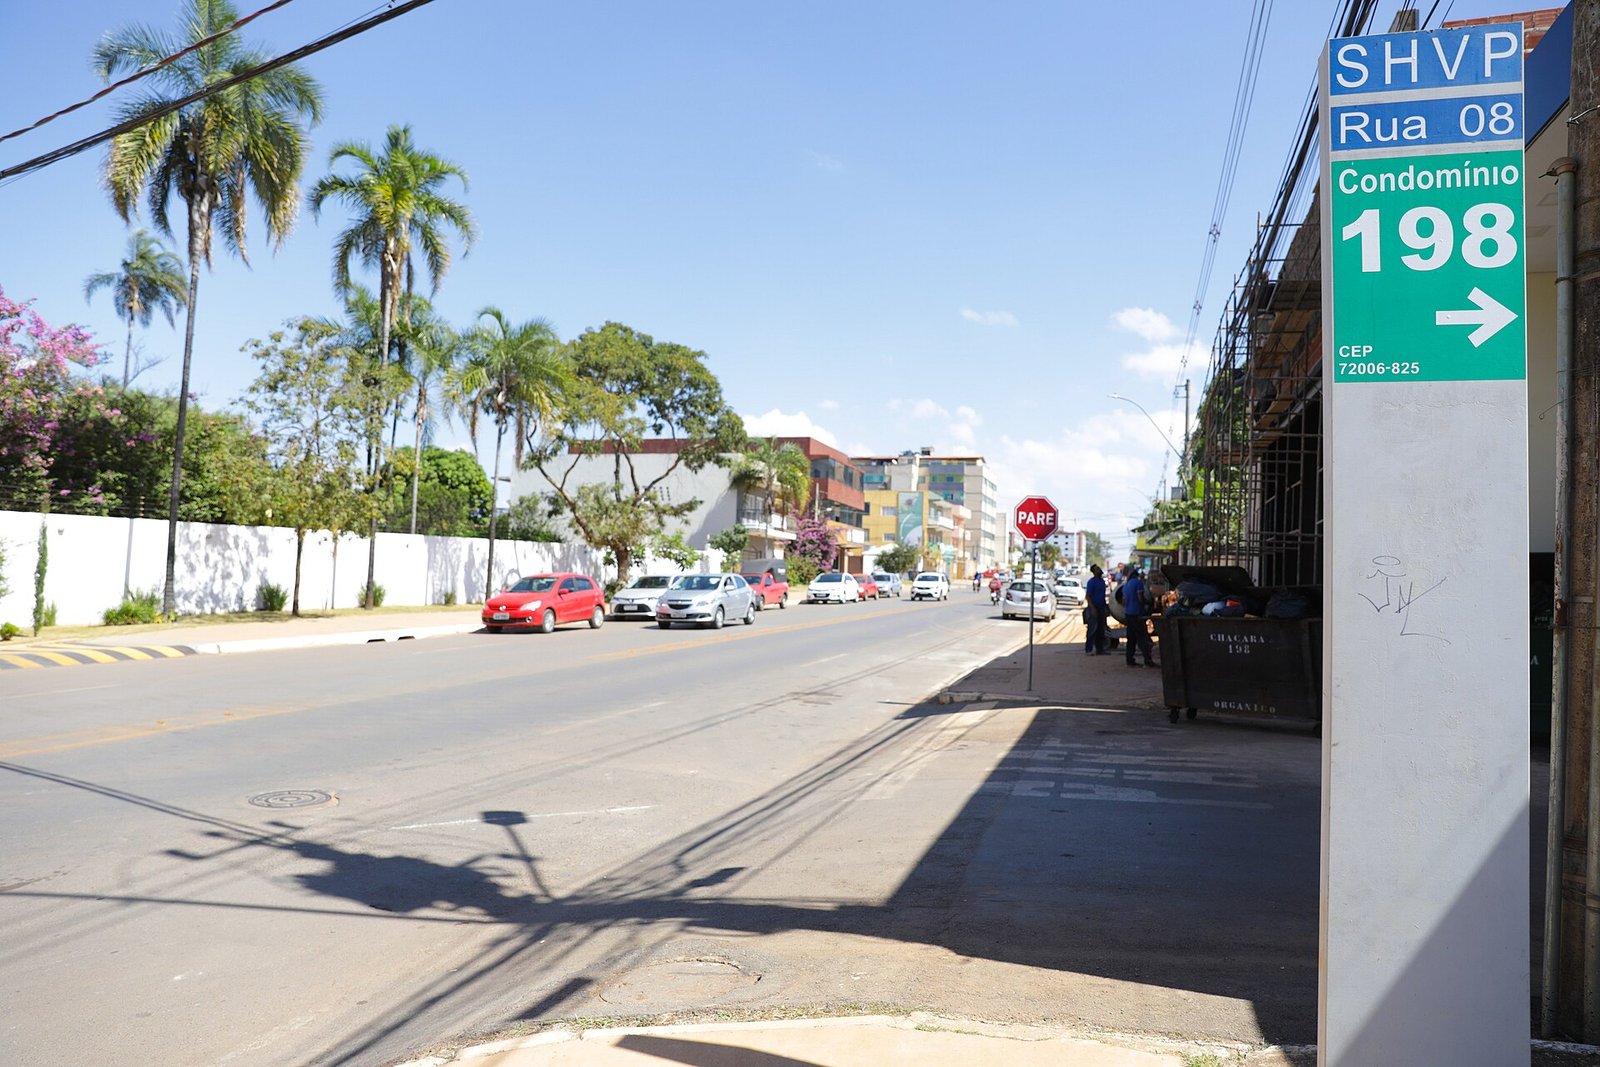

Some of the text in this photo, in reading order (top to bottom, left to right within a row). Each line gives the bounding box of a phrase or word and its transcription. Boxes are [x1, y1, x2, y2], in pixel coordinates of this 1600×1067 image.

[1335, 31, 1519, 89] SHVP
[1339, 102, 1515, 144] Rua 08
[1338, 160, 1520, 195] Condomínio
[1341, 202, 1519, 273] 198
[1338, 344, 1374, 359] CEP
[1338, 361, 1420, 376] 72006-825
[1017, 510, 1055, 526] PARE
[1228, 644, 1250, 654] 198
